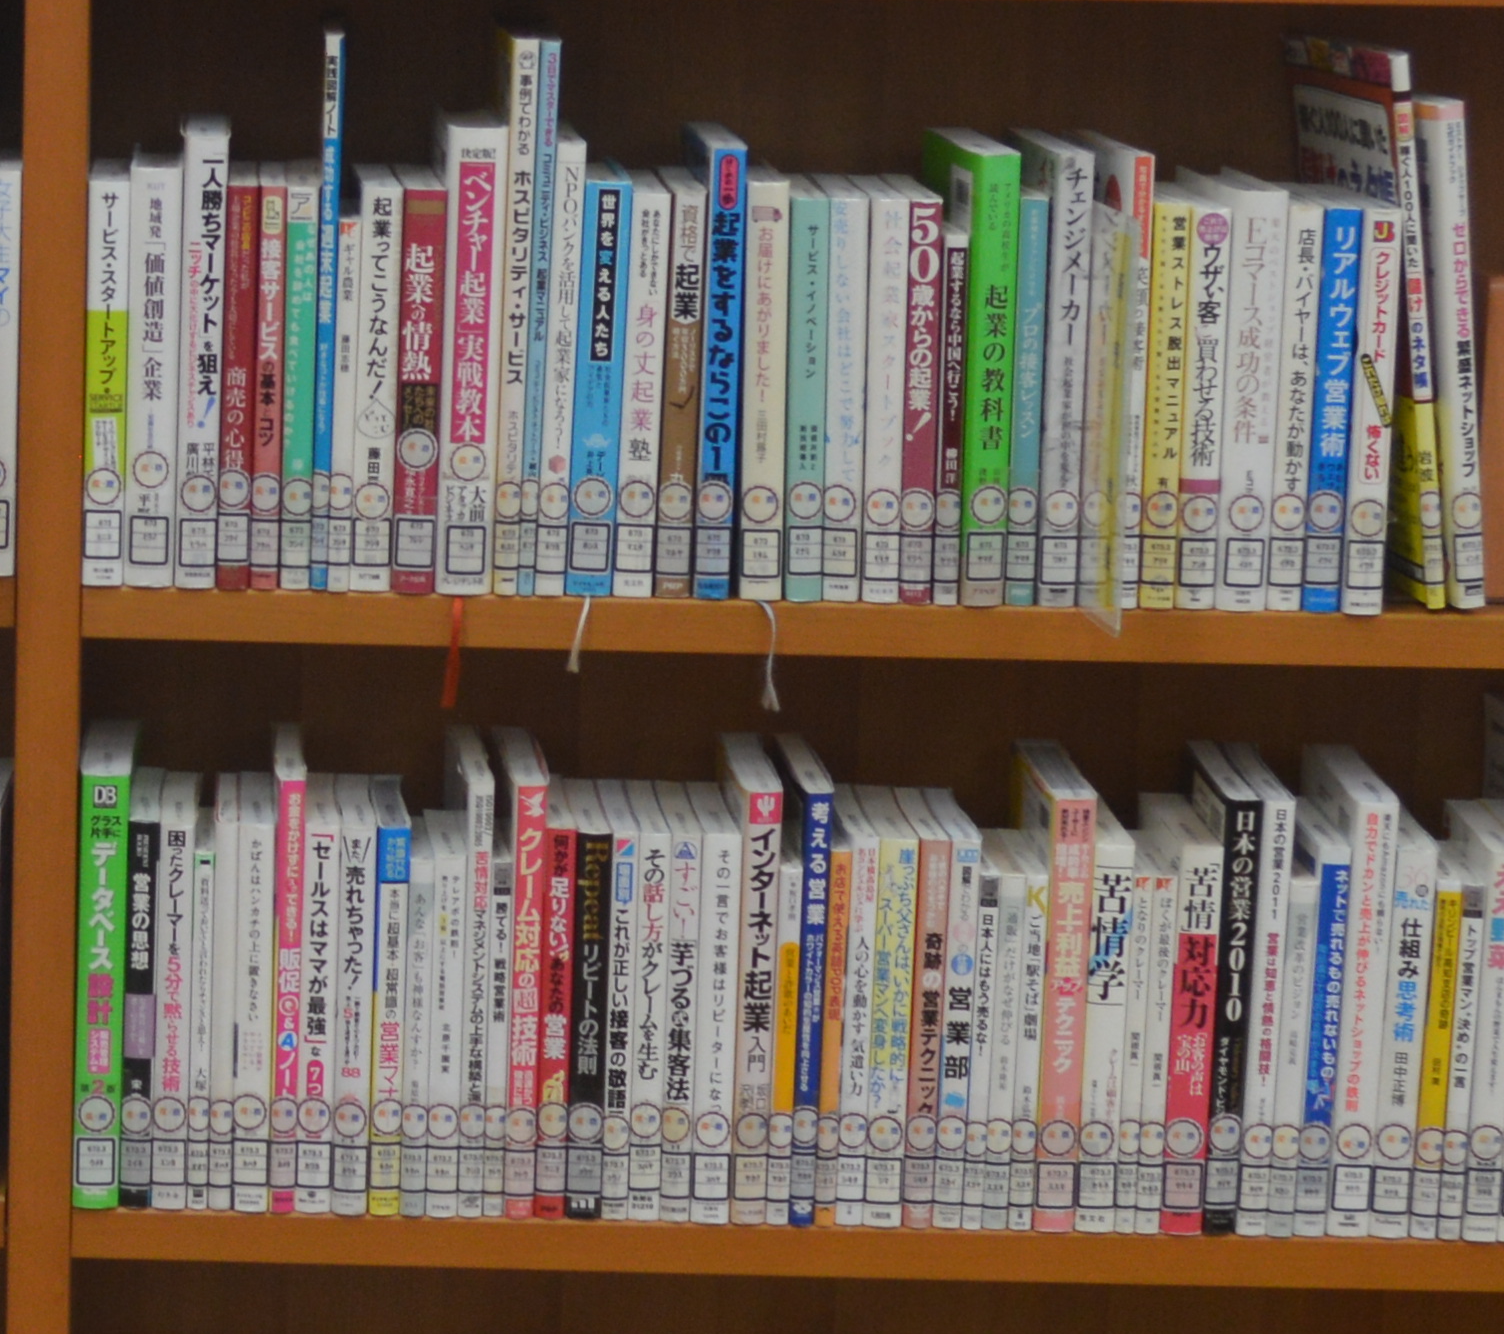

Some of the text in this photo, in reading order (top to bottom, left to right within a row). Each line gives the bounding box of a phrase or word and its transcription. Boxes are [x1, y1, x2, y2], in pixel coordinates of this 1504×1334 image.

[257, 239, 283, 448] 接客サービスの基本とコツ
[401, 242, 437, 381] 起業への情熱
[593, 191, 618, 361] 世界を変える人たち
[752, 226, 776, 405] お届けにあがりました！
[905, 203, 941, 443] 50歳からの起業！
[978, 281, 1010, 452] 起業の教科書
[1162, 215, 1187, 463] 営業ストレス脱出マニュアル
[1319, 225, 1359, 459] リアルウェブ営業術
[131, 873, 151, 971] 営業の思想
[637, 849, 665, 1081] その話し方がクレームを生む
